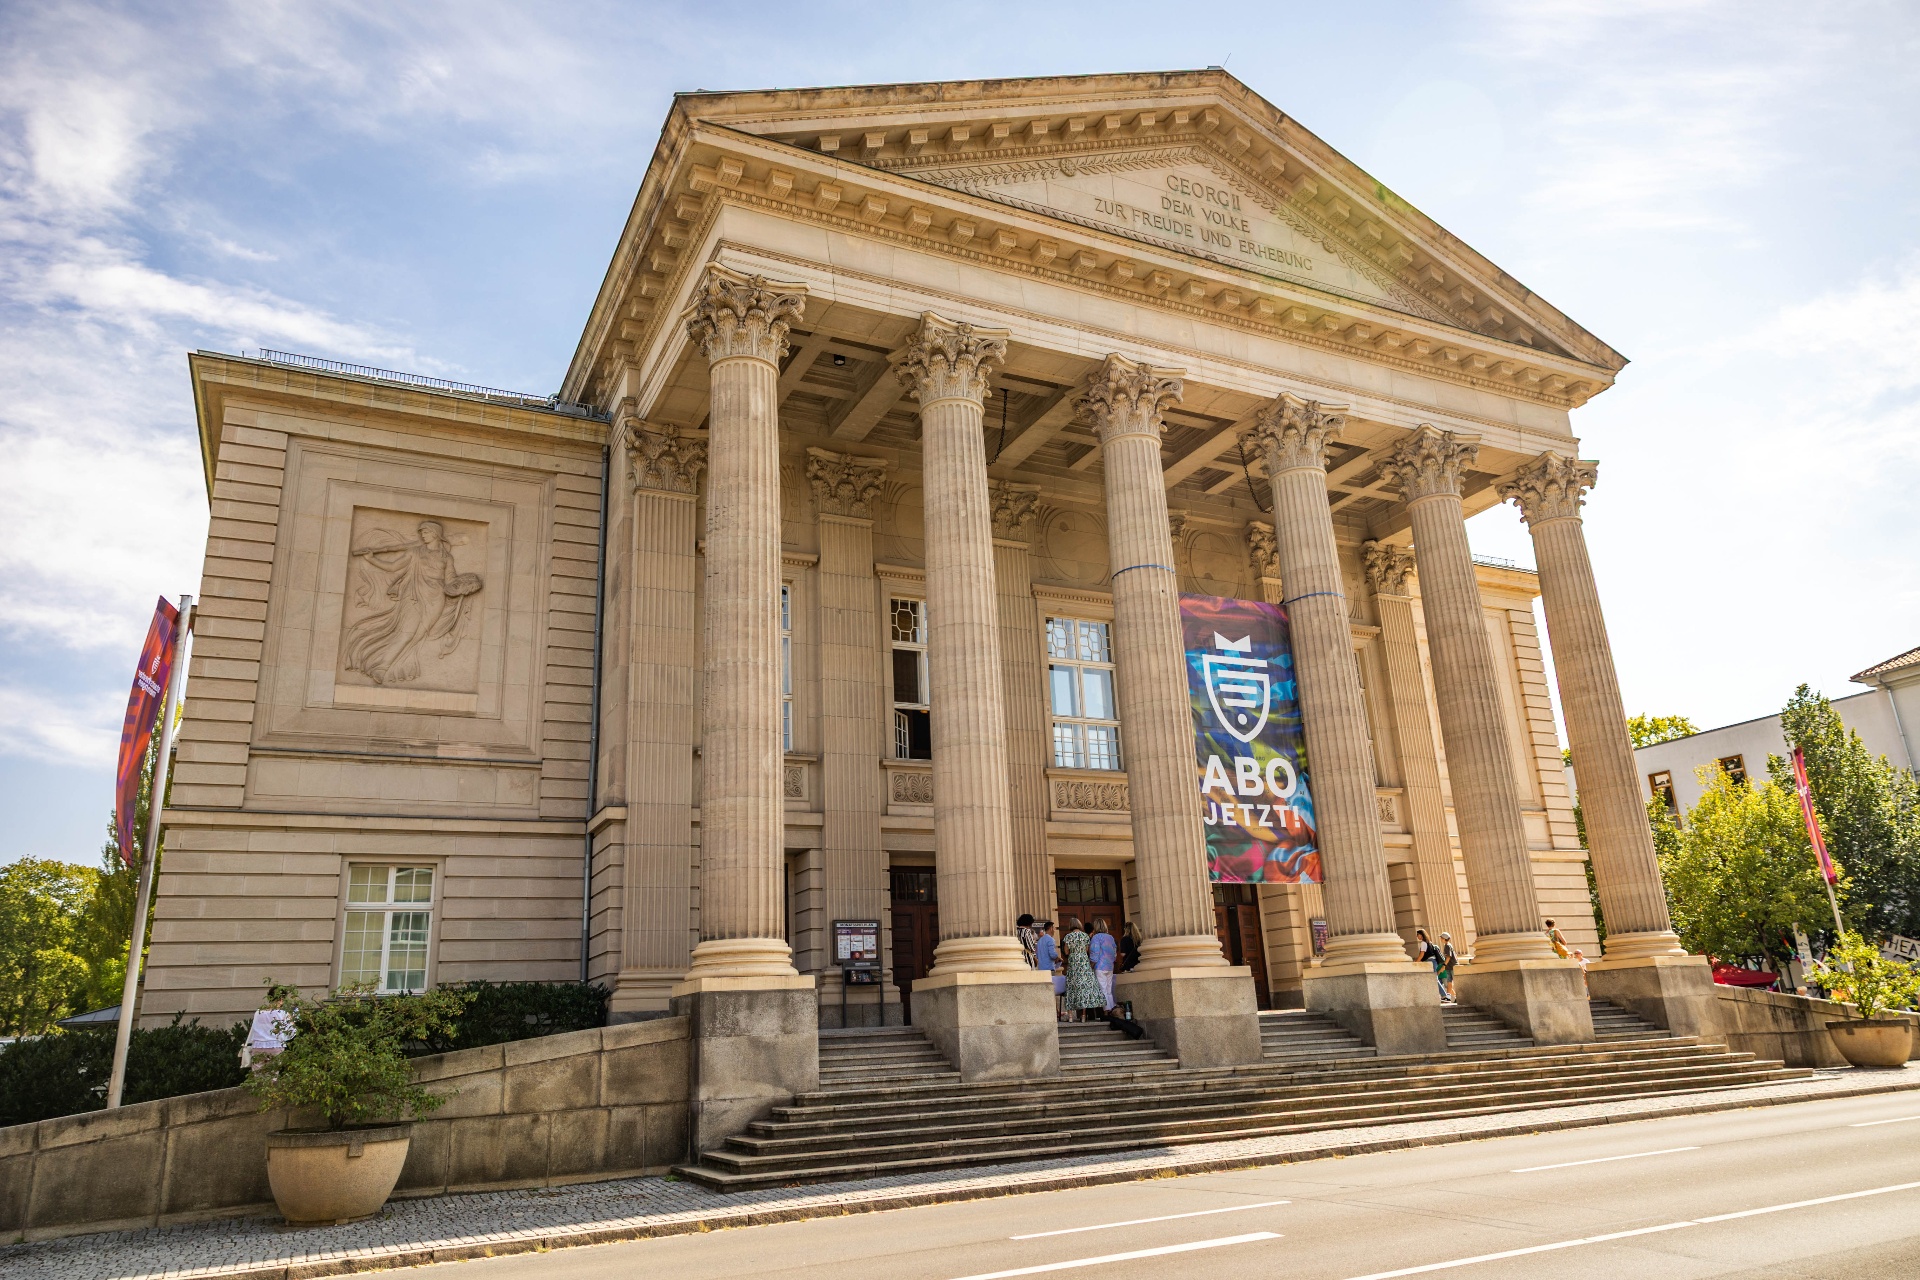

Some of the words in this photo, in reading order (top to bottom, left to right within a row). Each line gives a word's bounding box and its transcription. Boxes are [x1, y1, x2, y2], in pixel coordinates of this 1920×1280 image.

[1094, 197, 1128, 220] ZUR
[1131, 206, 1195, 238] FREUDE
[1199, 227, 1233, 248] UND
[1238, 238, 1314, 271] ERHEBUNG
[1160, 195, 1196, 218] DEM
[1200, 207, 1251, 234] VOLKE
[1201, 754, 1297, 799] ABO
[1203, 802, 1301, 828] JETZT!
